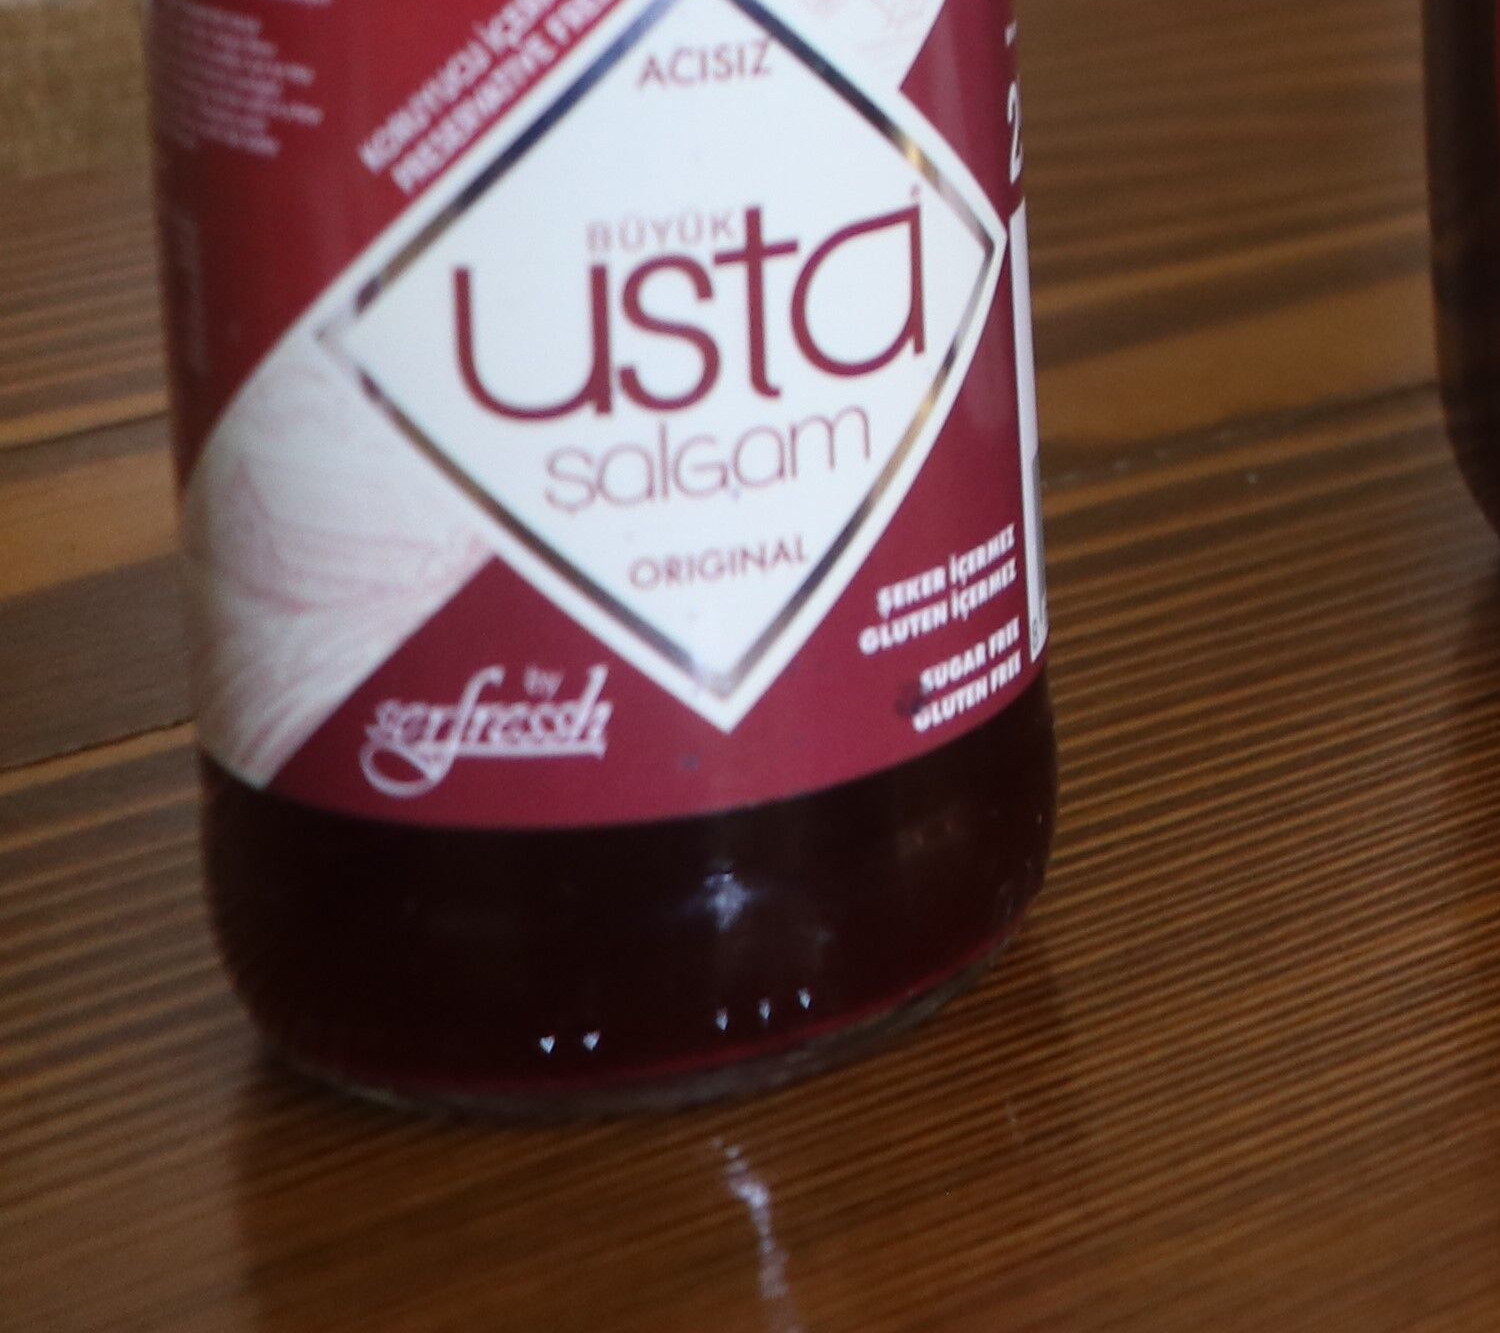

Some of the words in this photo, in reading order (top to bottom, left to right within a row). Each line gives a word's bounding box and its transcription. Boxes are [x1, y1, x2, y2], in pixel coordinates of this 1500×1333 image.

[634, 39, 774, 90] ACISIZ
[358, 37, 492, 176] KORUYUCU
[390, 34, 558, 197] PRESERVATIVE
[585, 210, 739, 256] BÜYÜK
[452, 198, 927, 422] usta
[628, 537, 808, 592] ORIGINAL
[876, 566, 947, 619] ŞEKER
[858, 598, 948, 655] GLUTEN
[919, 641, 986, 696] SUGAR
[988, 615, 1020, 660] FREE
[989, 648, 1022, 694] FREE
